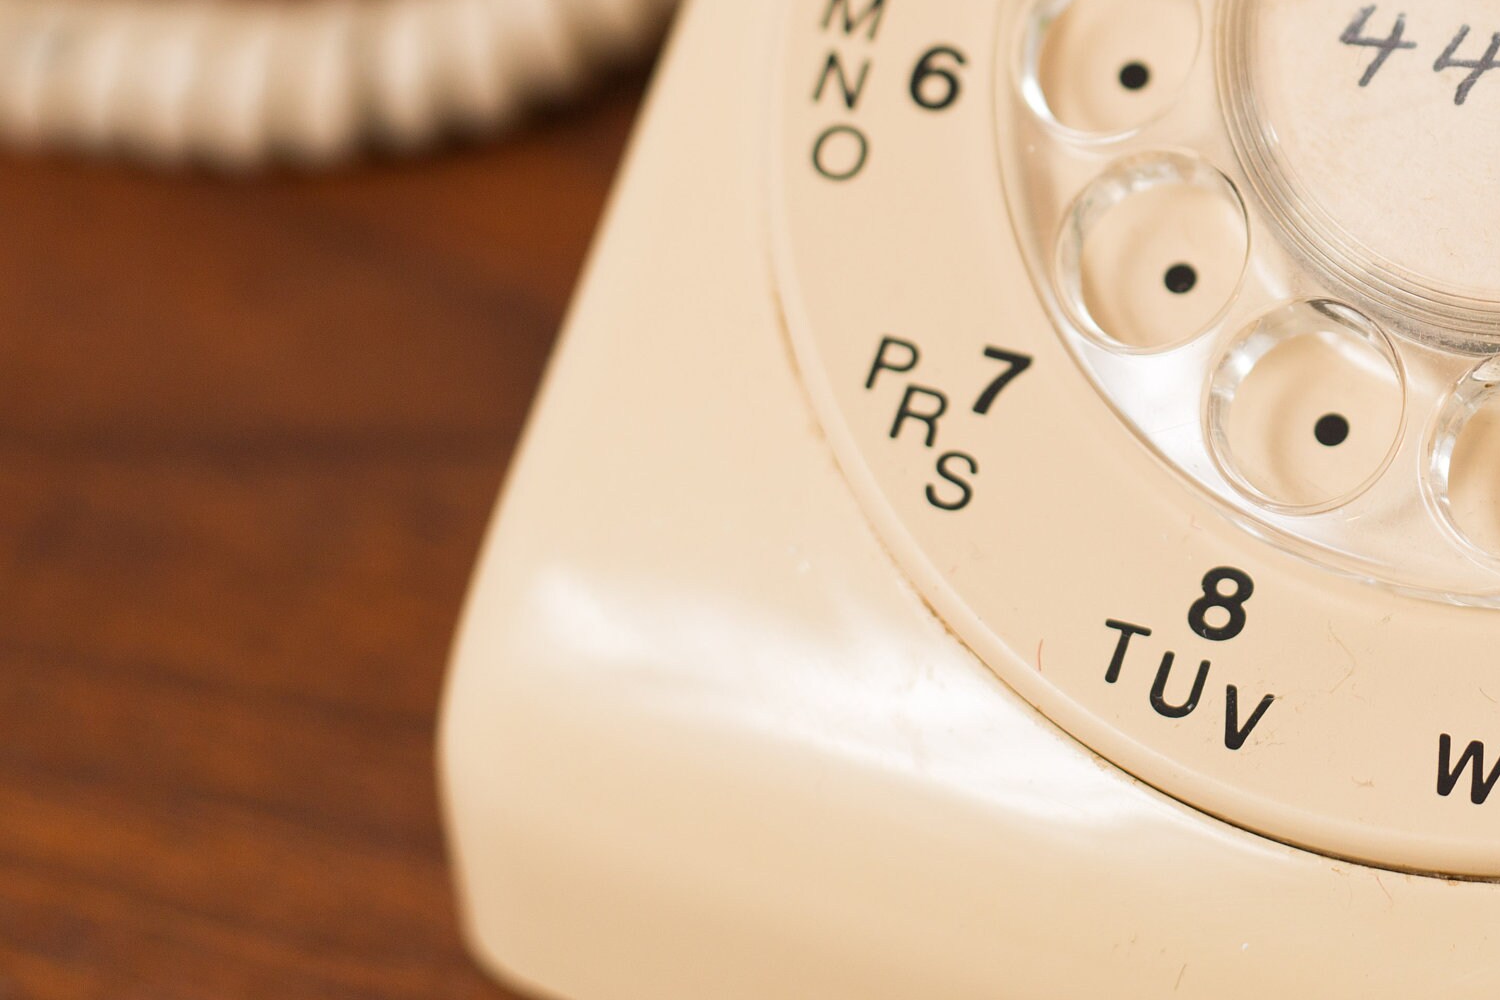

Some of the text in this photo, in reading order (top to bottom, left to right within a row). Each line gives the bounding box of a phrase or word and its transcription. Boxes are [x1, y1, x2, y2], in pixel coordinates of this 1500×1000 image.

[907, 44, 969, 113] 6
[971, 345, 1034, 416] 7
[1187, 565, 1255, 642] 8
[1104, 618, 1276, 752] TUV
